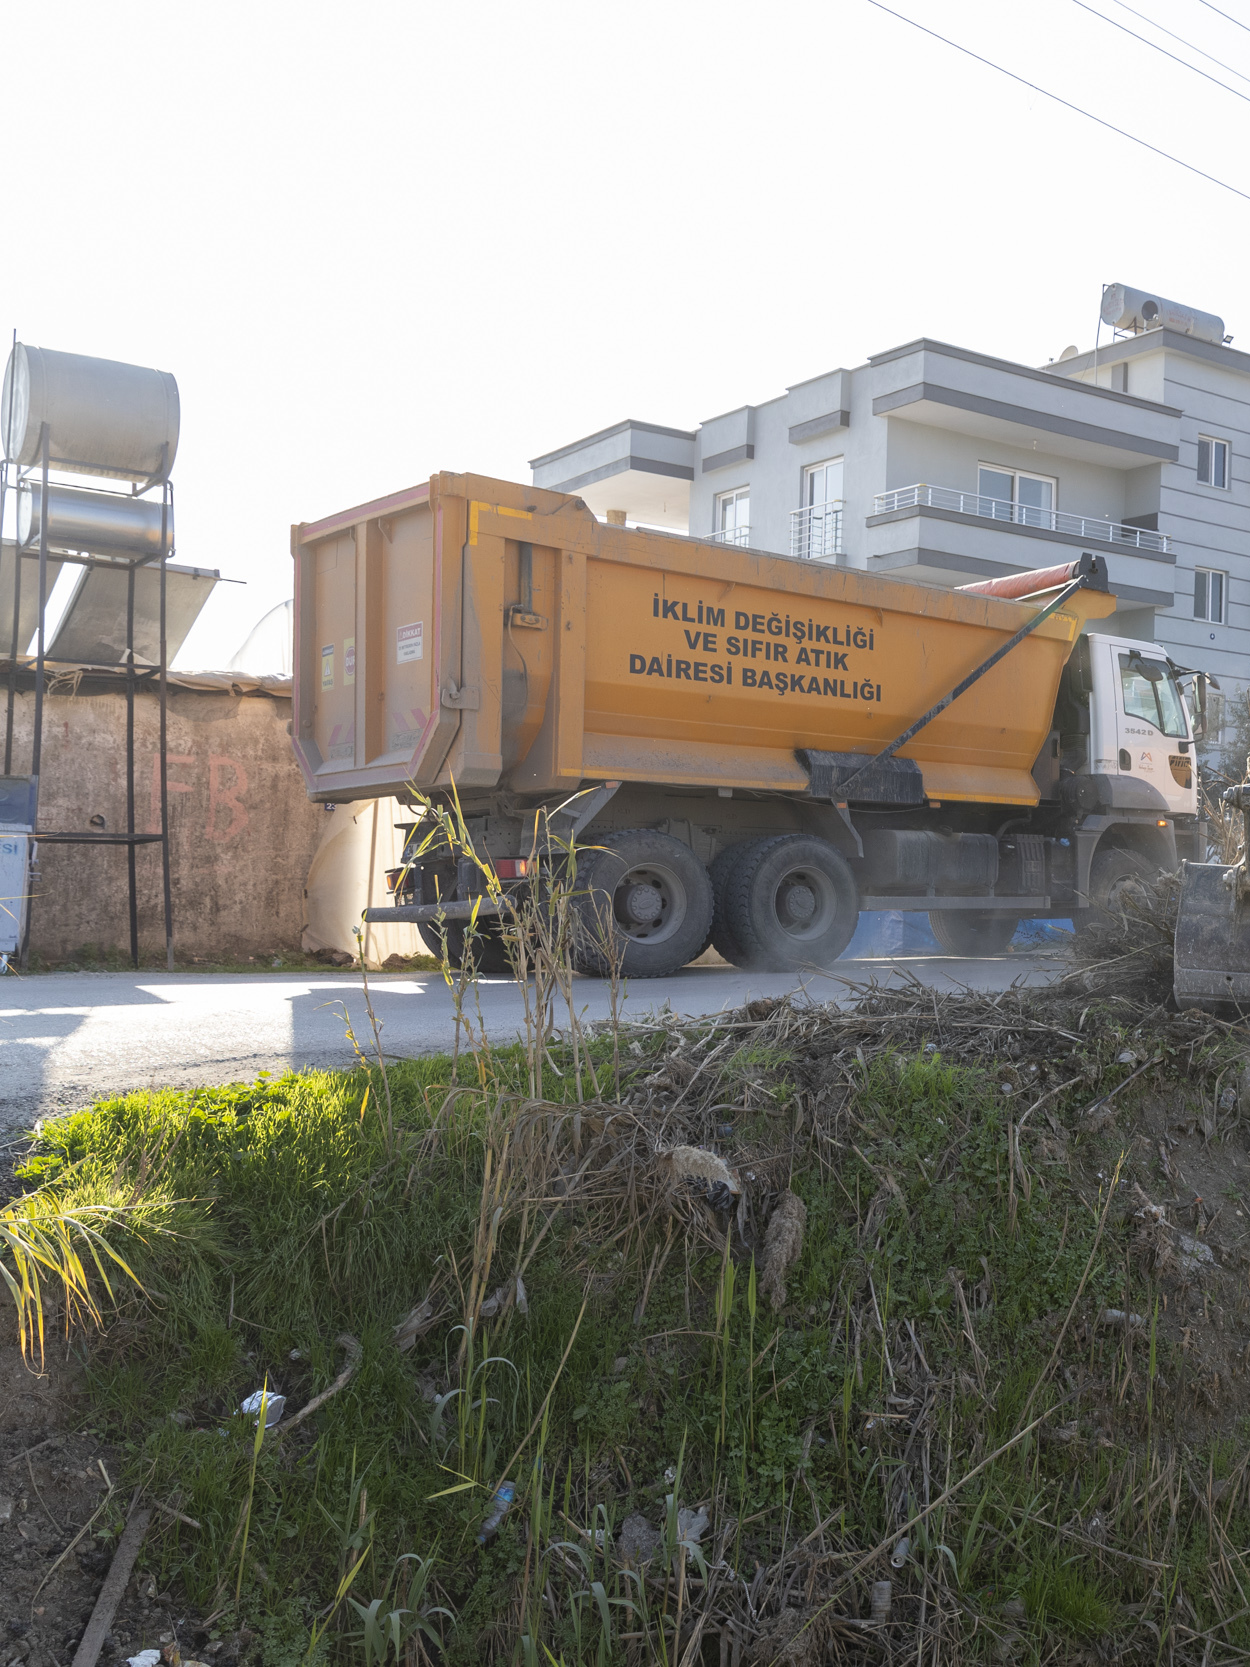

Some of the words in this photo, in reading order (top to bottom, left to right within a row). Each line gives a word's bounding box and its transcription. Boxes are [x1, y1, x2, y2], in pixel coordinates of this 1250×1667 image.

[402, 627, 421, 639] DİKKAT
[653, 593, 725, 627] İKLİM
[734, 611, 874, 650] DEĞİŞİKLİĞİ
[684, 629, 717, 652] VE
[726, 636, 788, 663] SIFIR
[796, 646, 849, 671] ATIK
[629, 653, 732, 685] DAİRESİ
[742, 667, 881, 702] BAŞKANLIĞI
[146, 753, 249, 841] FB
